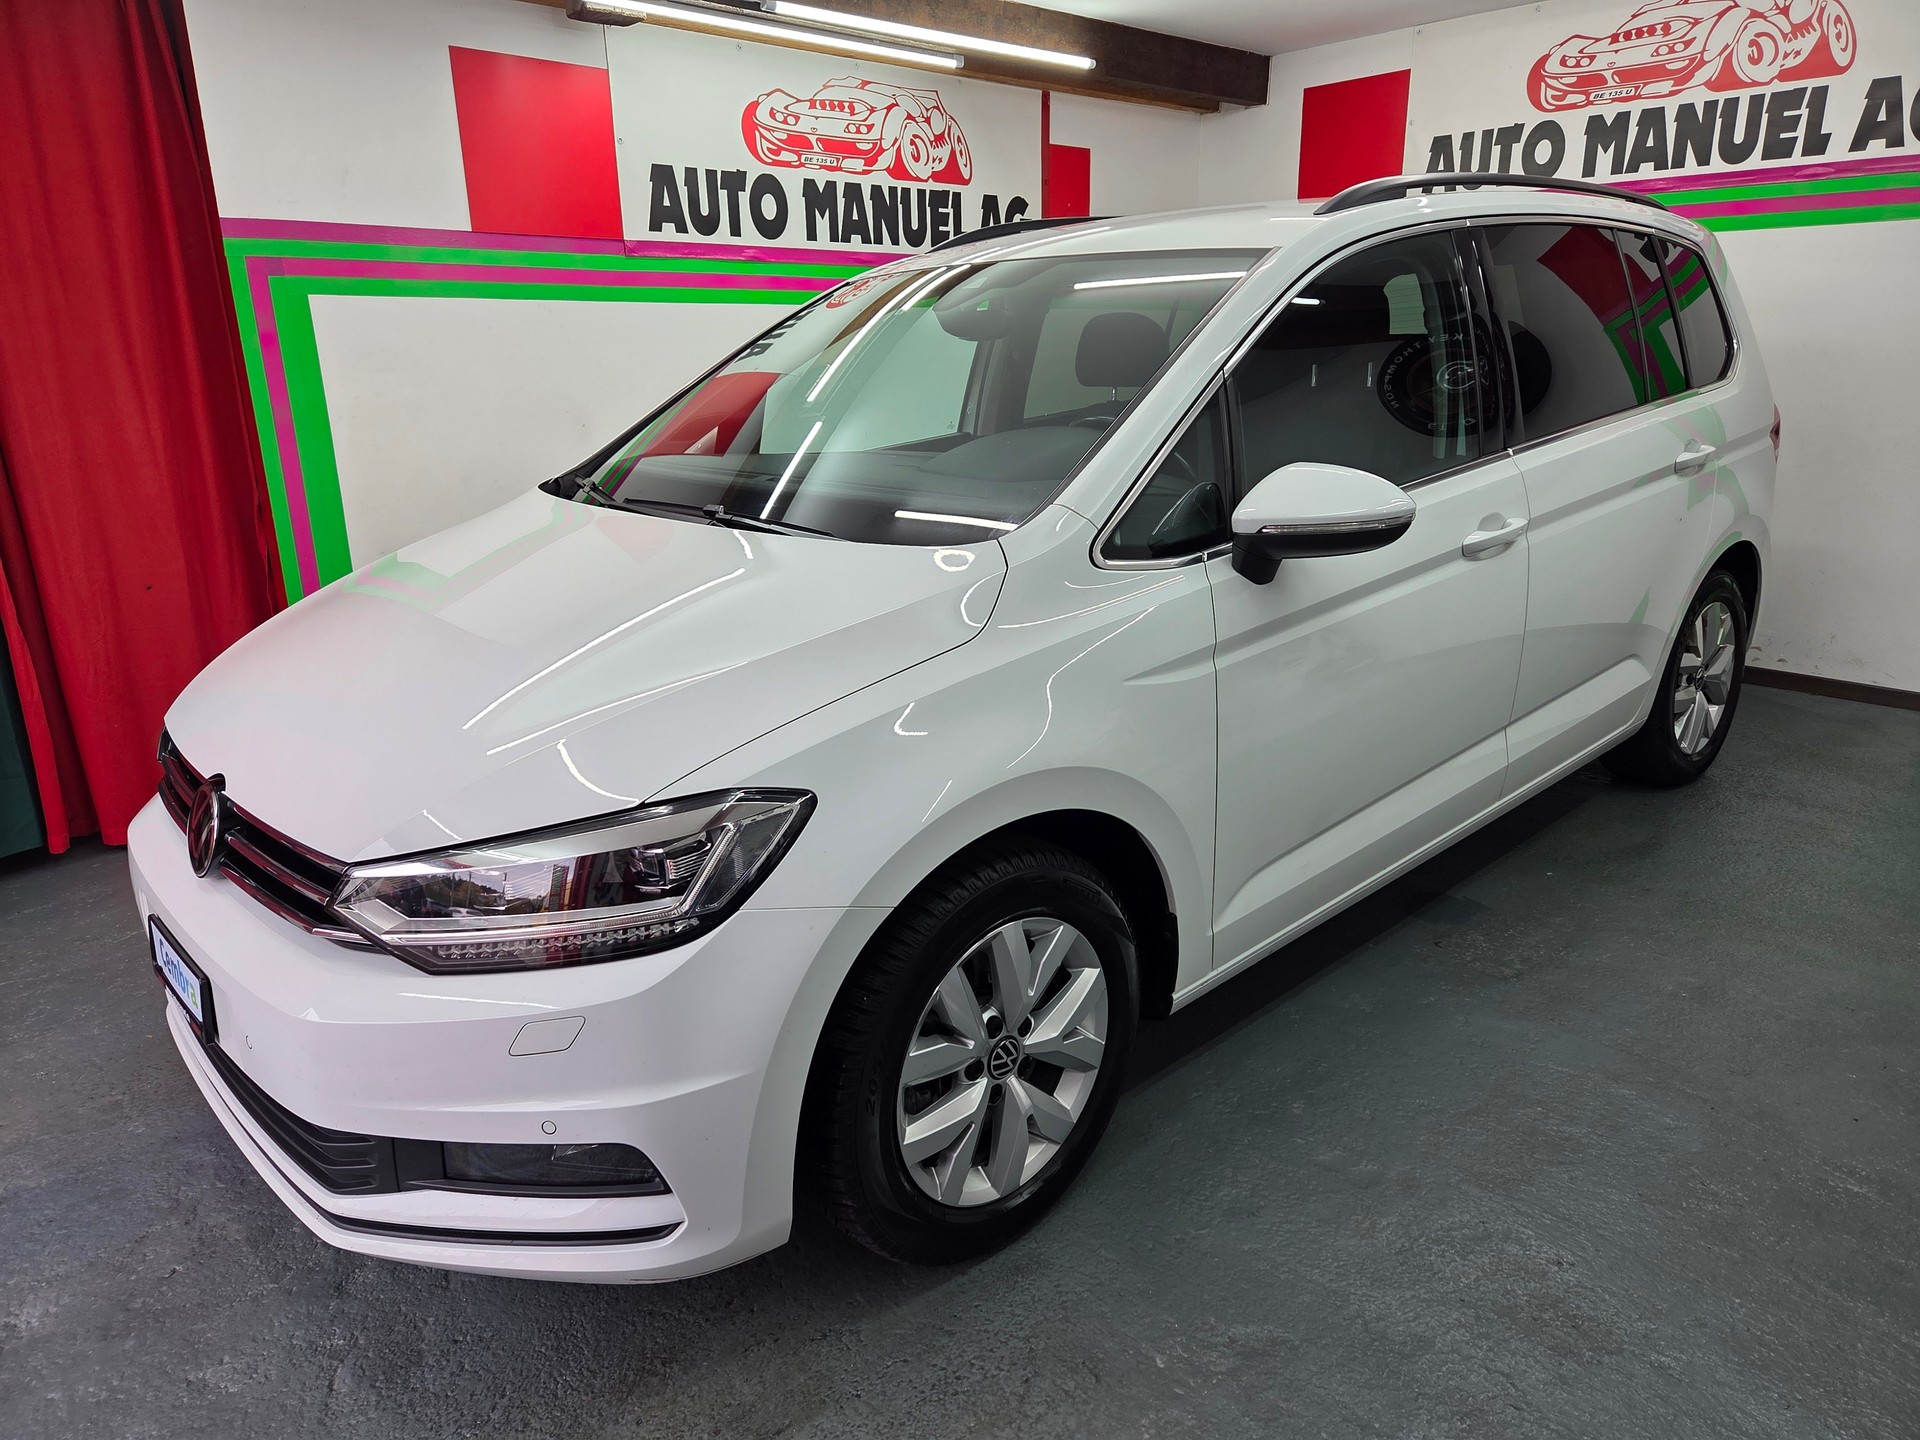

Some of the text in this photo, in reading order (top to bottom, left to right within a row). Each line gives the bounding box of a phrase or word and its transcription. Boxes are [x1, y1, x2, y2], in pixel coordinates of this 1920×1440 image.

[1421, 75, 1920, 193] AUTO MANUEL A
[648, 163, 789, 241] AUTO
[802, 178, 967, 248] MANUEL
[159, 938, 199, 1010] Cembra
